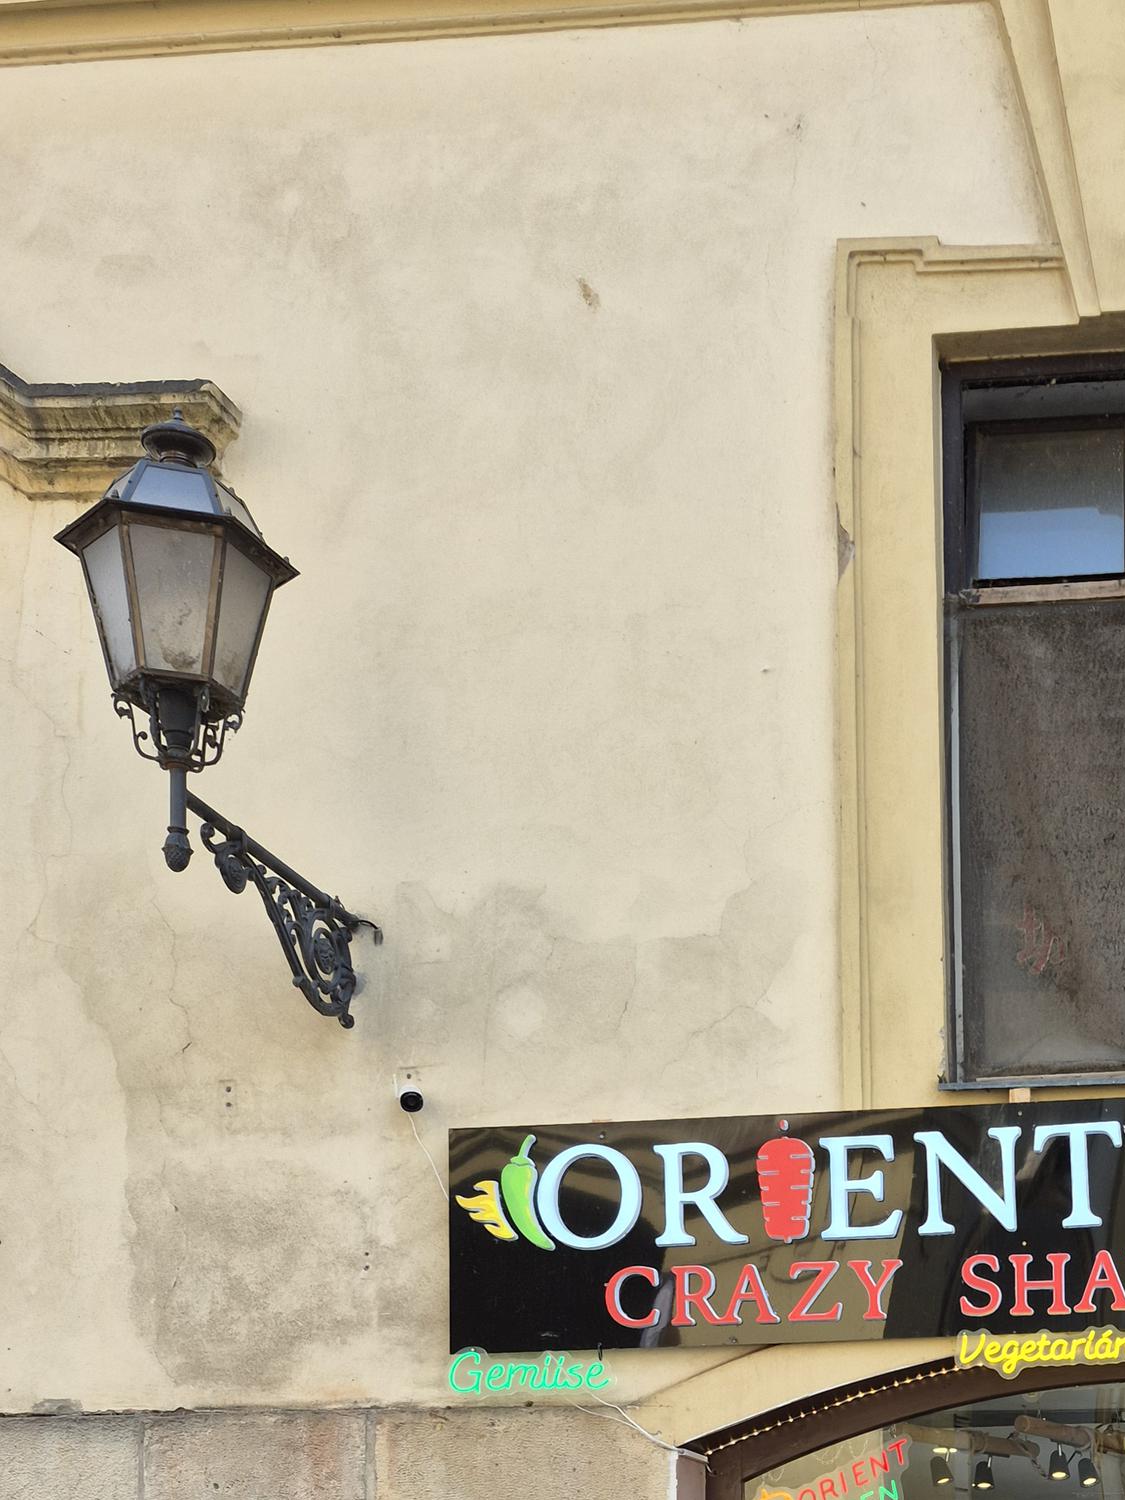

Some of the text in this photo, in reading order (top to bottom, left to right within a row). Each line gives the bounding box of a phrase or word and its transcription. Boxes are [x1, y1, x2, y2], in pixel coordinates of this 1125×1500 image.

[538, 1120, 1124, 1250] ORIENT
[604, 1258, 903, 1328] CRAZY
[448, 1352, 610, 1394] Gemüse
